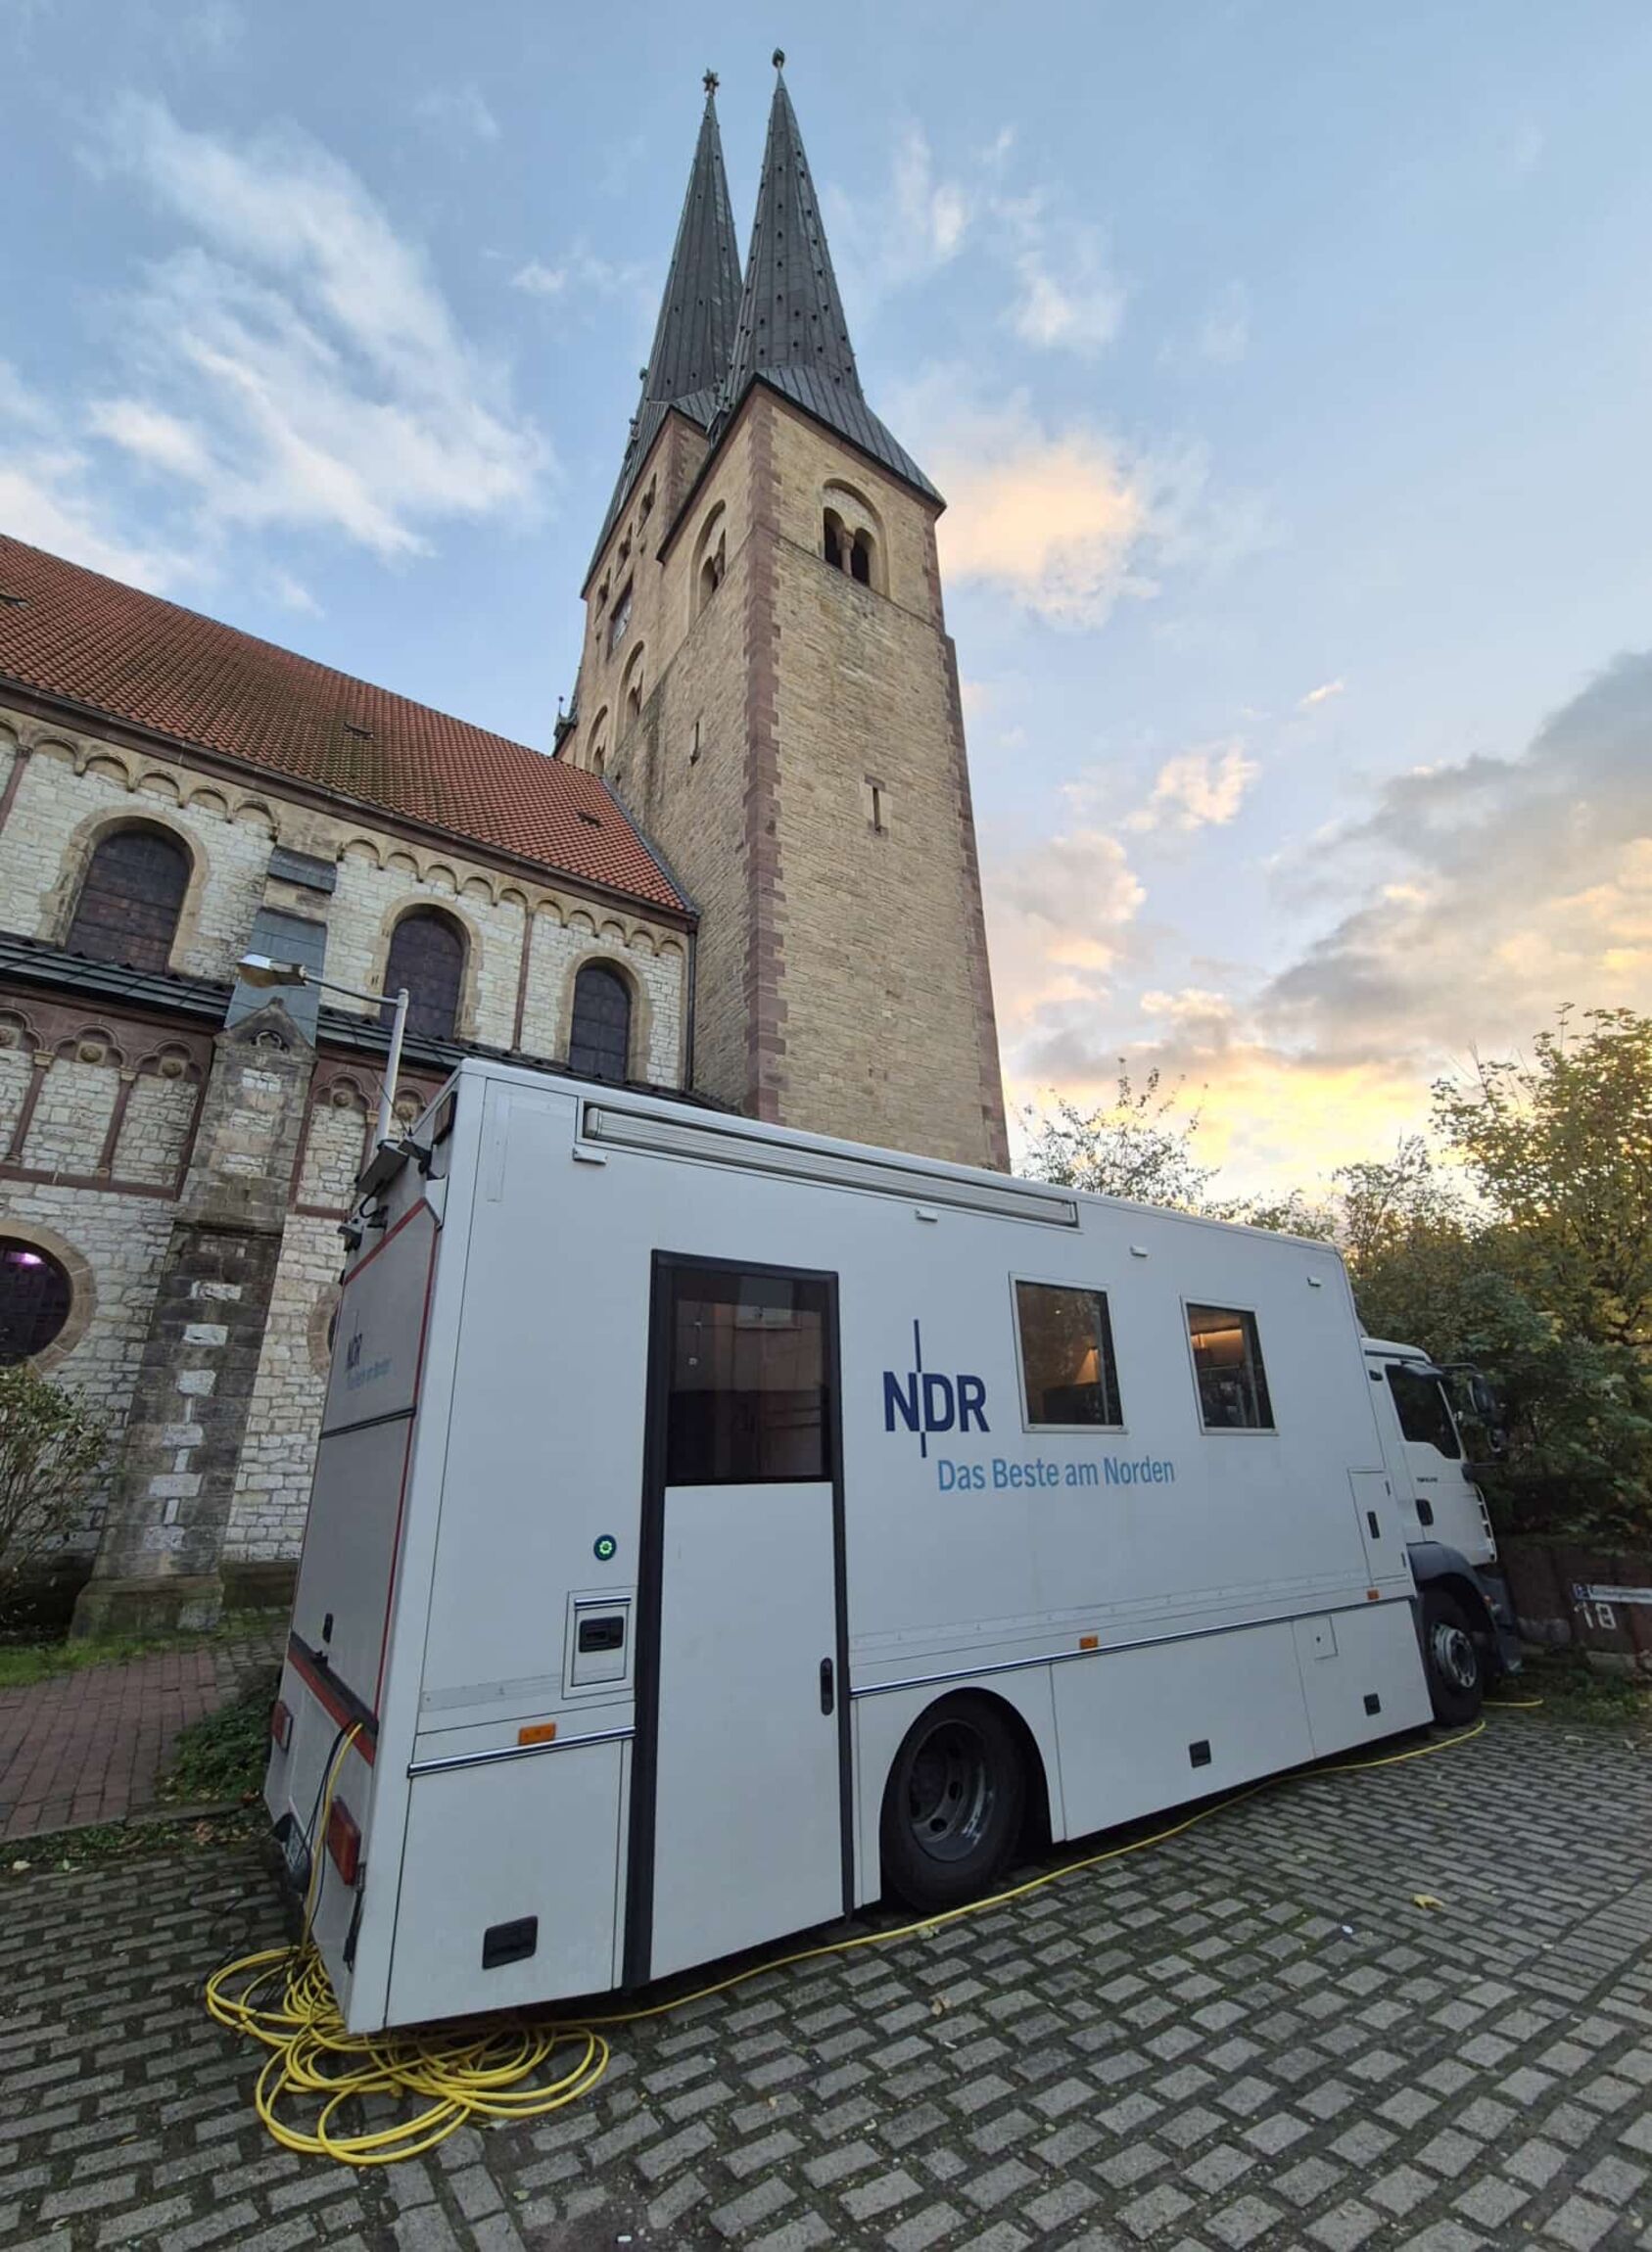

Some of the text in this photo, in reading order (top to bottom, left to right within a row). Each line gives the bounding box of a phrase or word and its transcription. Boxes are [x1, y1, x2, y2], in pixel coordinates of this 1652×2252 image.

[882, 1371, 991, 1432] NDR
[938, 1455, 1176, 1491] Das Beste am Norden
